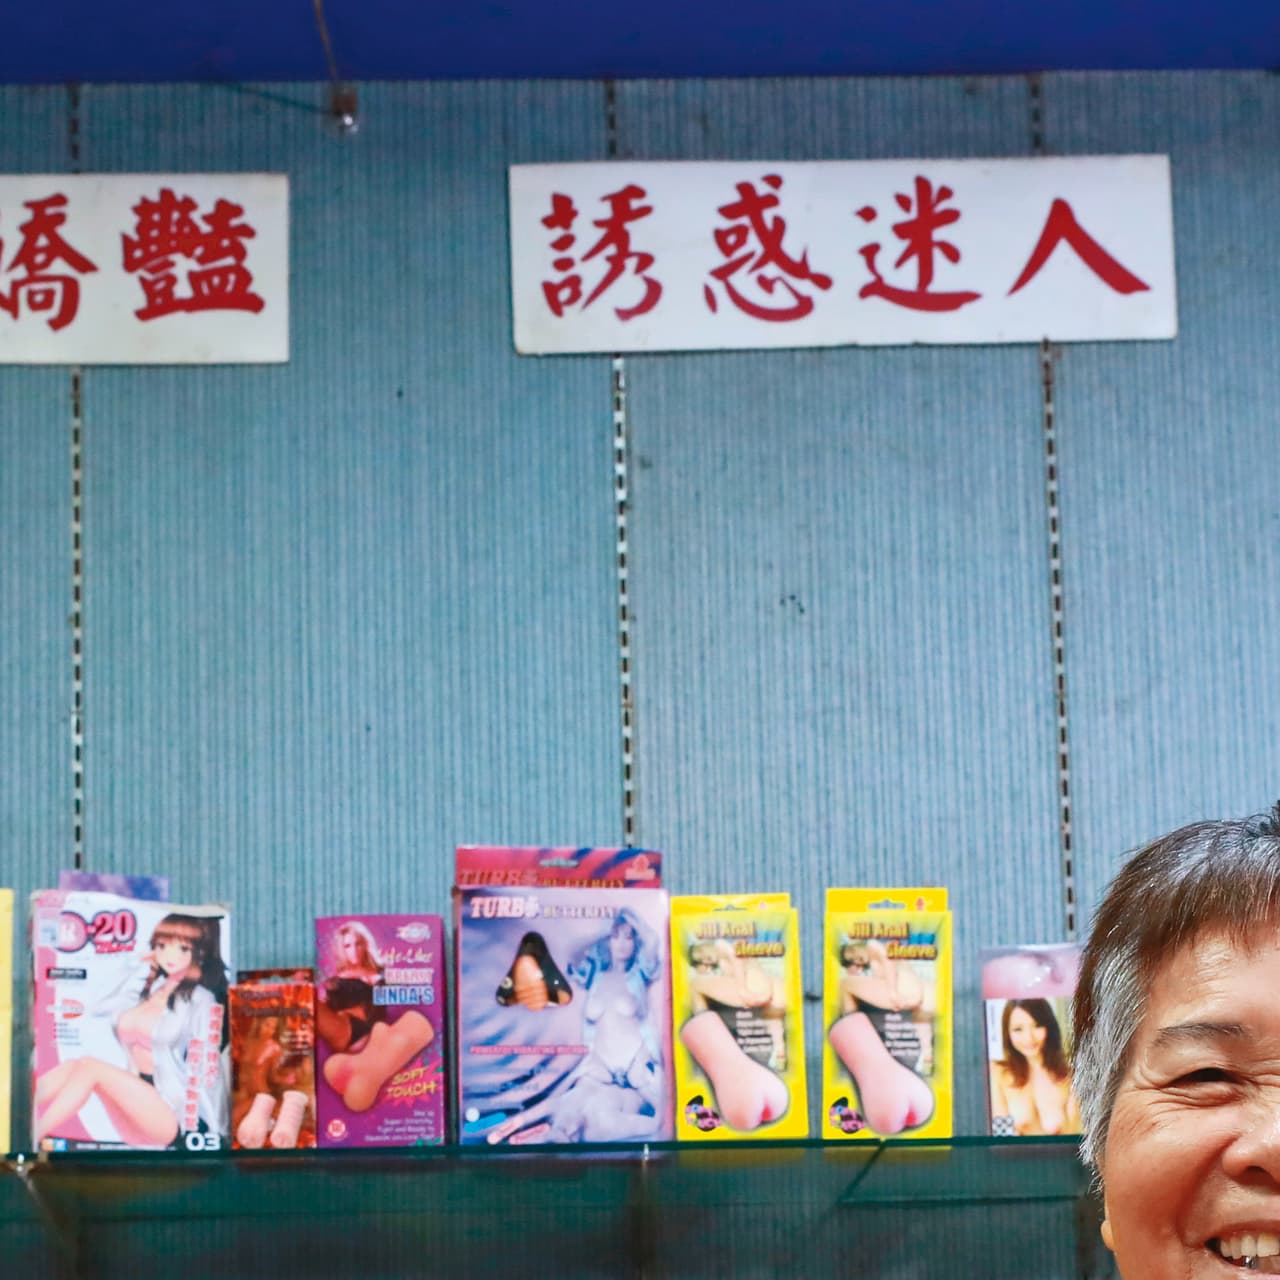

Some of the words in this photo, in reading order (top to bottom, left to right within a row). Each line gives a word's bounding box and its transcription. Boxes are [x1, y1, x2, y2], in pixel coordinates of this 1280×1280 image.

[542, 175, 1150, 324] 誘惑迷人
[373, 986, 434, 1006] LINDA'S
[392, 1067, 428, 1085] SOFT
[387, 1081, 437, 1098] TOUCH
[185, 1132, 221, 1151] 03
